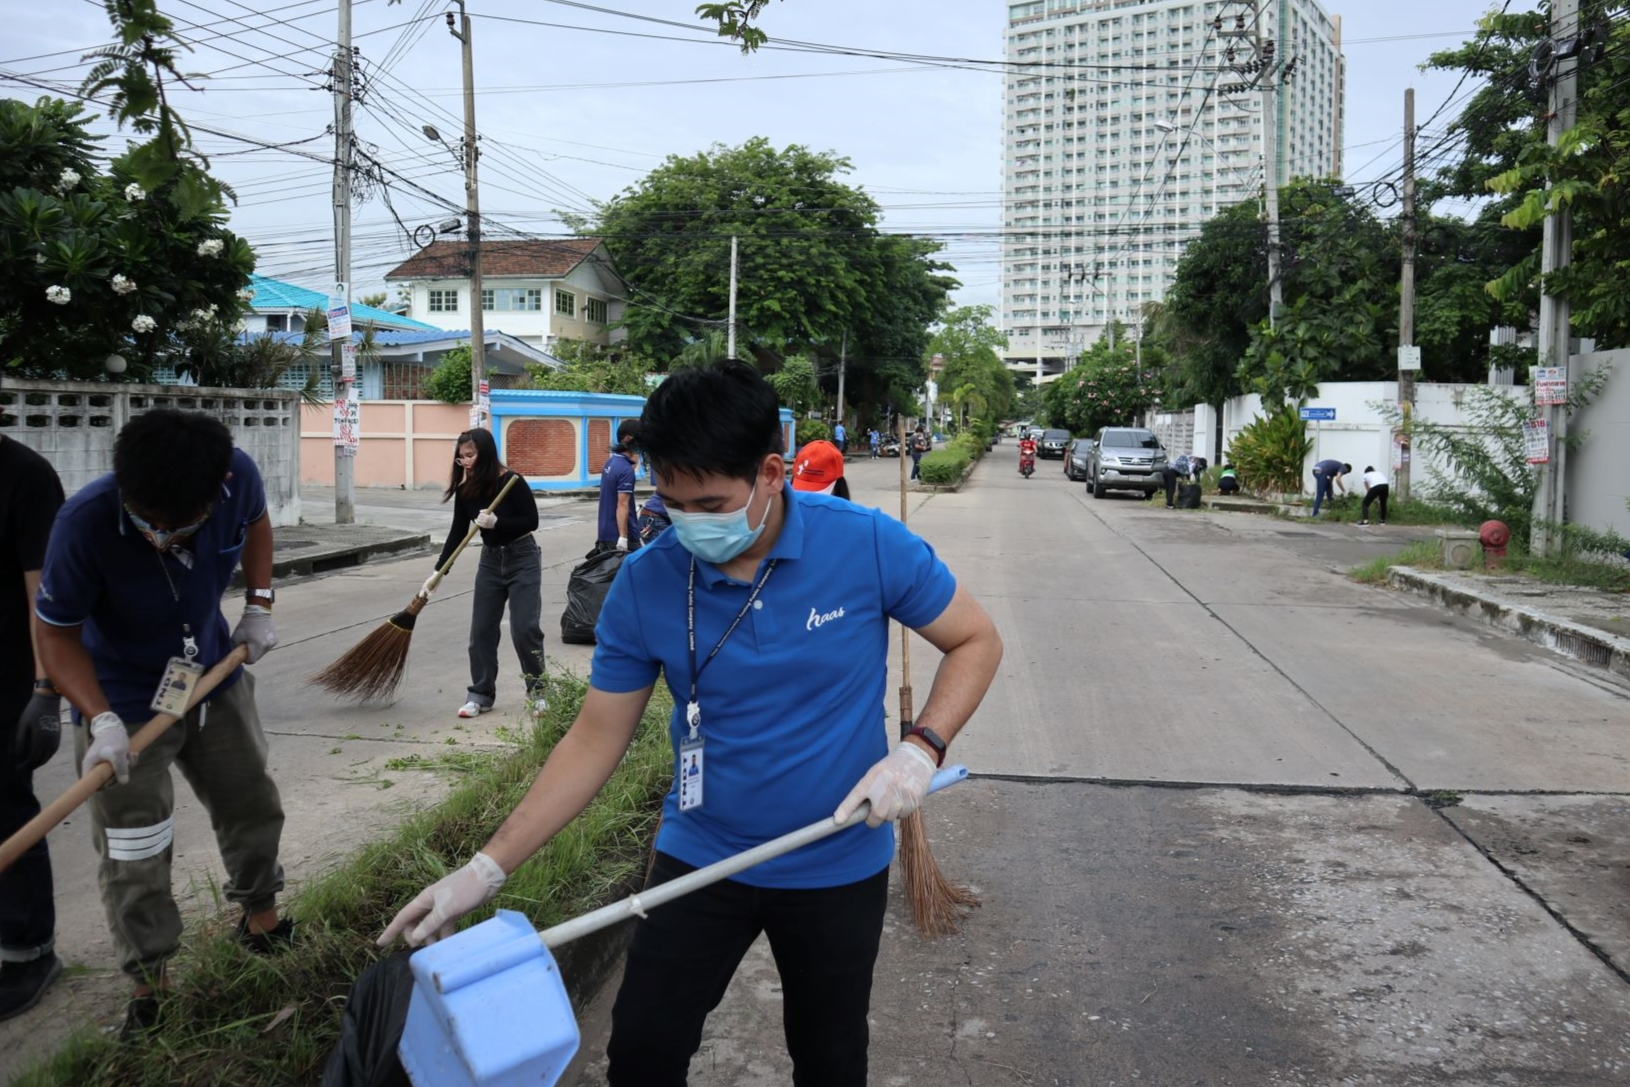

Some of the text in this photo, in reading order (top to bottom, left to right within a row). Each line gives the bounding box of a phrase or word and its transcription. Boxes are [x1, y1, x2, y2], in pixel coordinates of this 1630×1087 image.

[738, 602, 752, 618] Testing
[749, 588, 761, 602] Public
[758, 567, 773, 588] Company
[806, 606, 846, 631] haas
